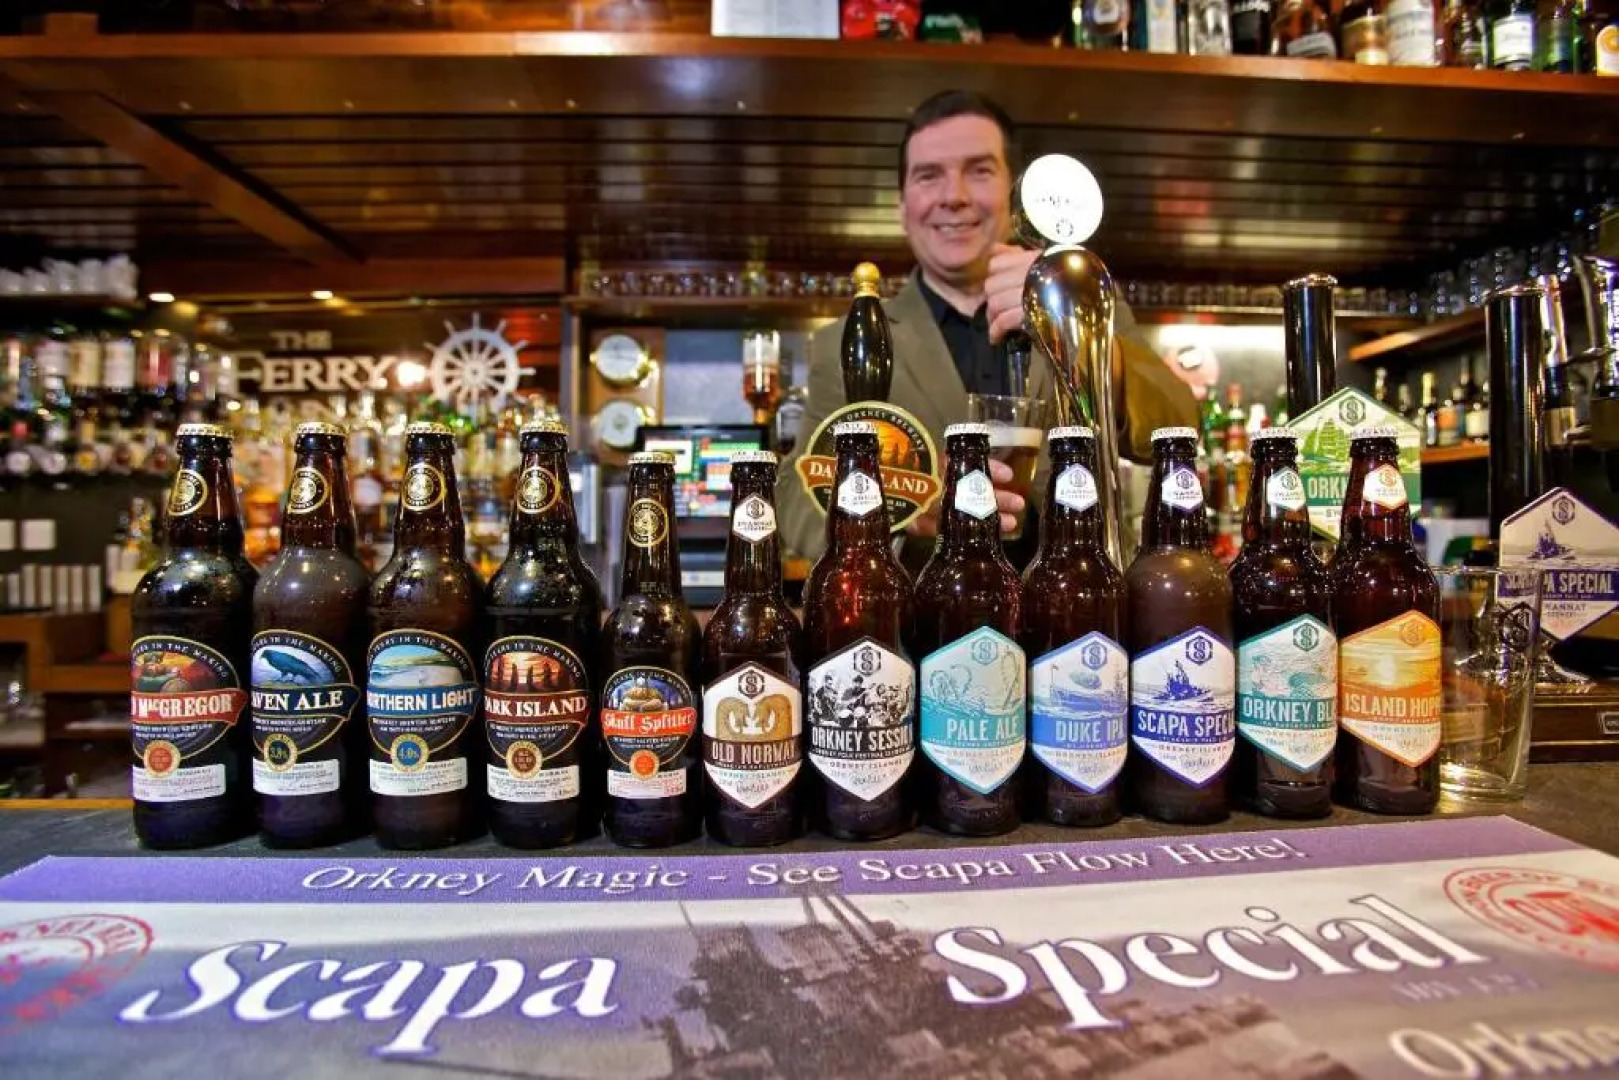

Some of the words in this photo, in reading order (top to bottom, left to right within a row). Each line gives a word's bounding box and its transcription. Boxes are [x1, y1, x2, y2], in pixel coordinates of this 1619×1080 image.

[231, 352, 396, 397] FERRY
[809, 460, 837, 479] DA
[880, 472, 929, 495] LAND
[1560, 573, 1614, 594] SPECIAL
[293, 689, 344, 711] ALE
[484, 695, 513, 717] ARK
[515, 696, 587, 718] ISLAND
[1242, 696, 1312, 722] ORKNEY
[1343, 692, 1407, 718] ISLAND
[946, 718, 989, 742] PALE
[995, 715, 1019, 742] ALE
[1055, 719, 1102, 742] DUKE
[1106, 717, 1126, 741] IPA
[1137, 709, 1190, 738] SCAPA
[712, 739, 735, 762] OLD
[811, 726, 864, 752] ORKNEY
[301, 865, 501, 896] Orkney
[517, 863, 690, 895] Magic
[746, 861, 842, 886] See
[858, 857, 1014, 886] Scapa
[1021, 849, 1150, 874] Flow
[1154, 837, 1310, 866] Here!
[116, 940, 620, 1058] Scapa
[929, 892, 1493, 1032] Special
